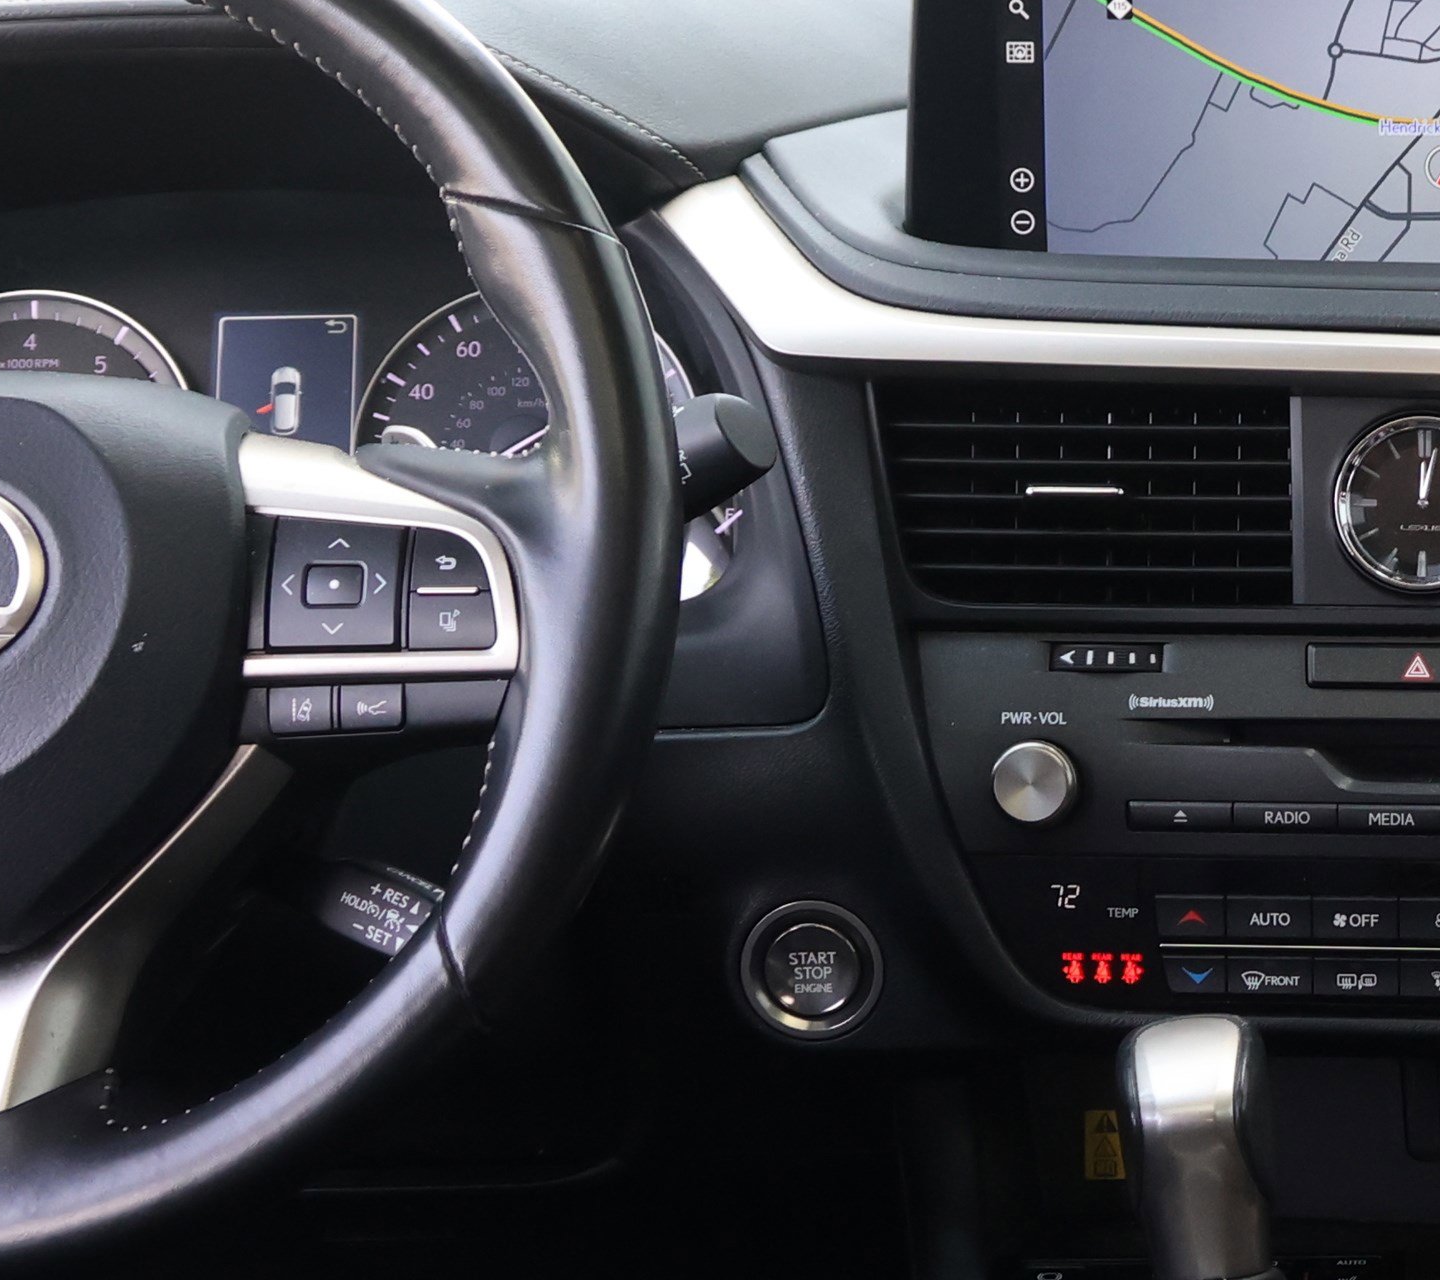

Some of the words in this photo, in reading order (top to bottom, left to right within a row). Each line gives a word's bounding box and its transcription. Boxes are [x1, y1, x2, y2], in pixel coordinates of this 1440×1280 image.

[1113, 1, 1128, 11] 115
[1380, 121, 1440, 134] Hendrick
[1340, 228, 1361, 251] Rd
[23, 333, 38, 350] 4
[456, 340, 481, 357] 60
[94, 355, 108, 374] 5
[511, 376, 530, 387] 120
[408, 383, 434, 400] 40
[486, 385, 506, 397] 100
[469, 400, 484, 410] 80
[456, 418, 471, 429] 60
[450, 438, 466, 448] 40
[1264, 811, 1310, 824] RADIO
[1368, 812, 1414, 826] MEDIA
[340, 891, 369, 912] HOLD
[1050, 884, 1080, 909] 72
[1107, 907, 1139, 918] TEMP
[1250, 913, 1291, 927] AUTO
[1349, 913, 1379, 927] OFF
[788, 951, 836, 965] START
[794, 966, 832, 980] STOP
[1265, 975, 1300, 987] FRONT
[794, 983, 833, 994] ENGINE
